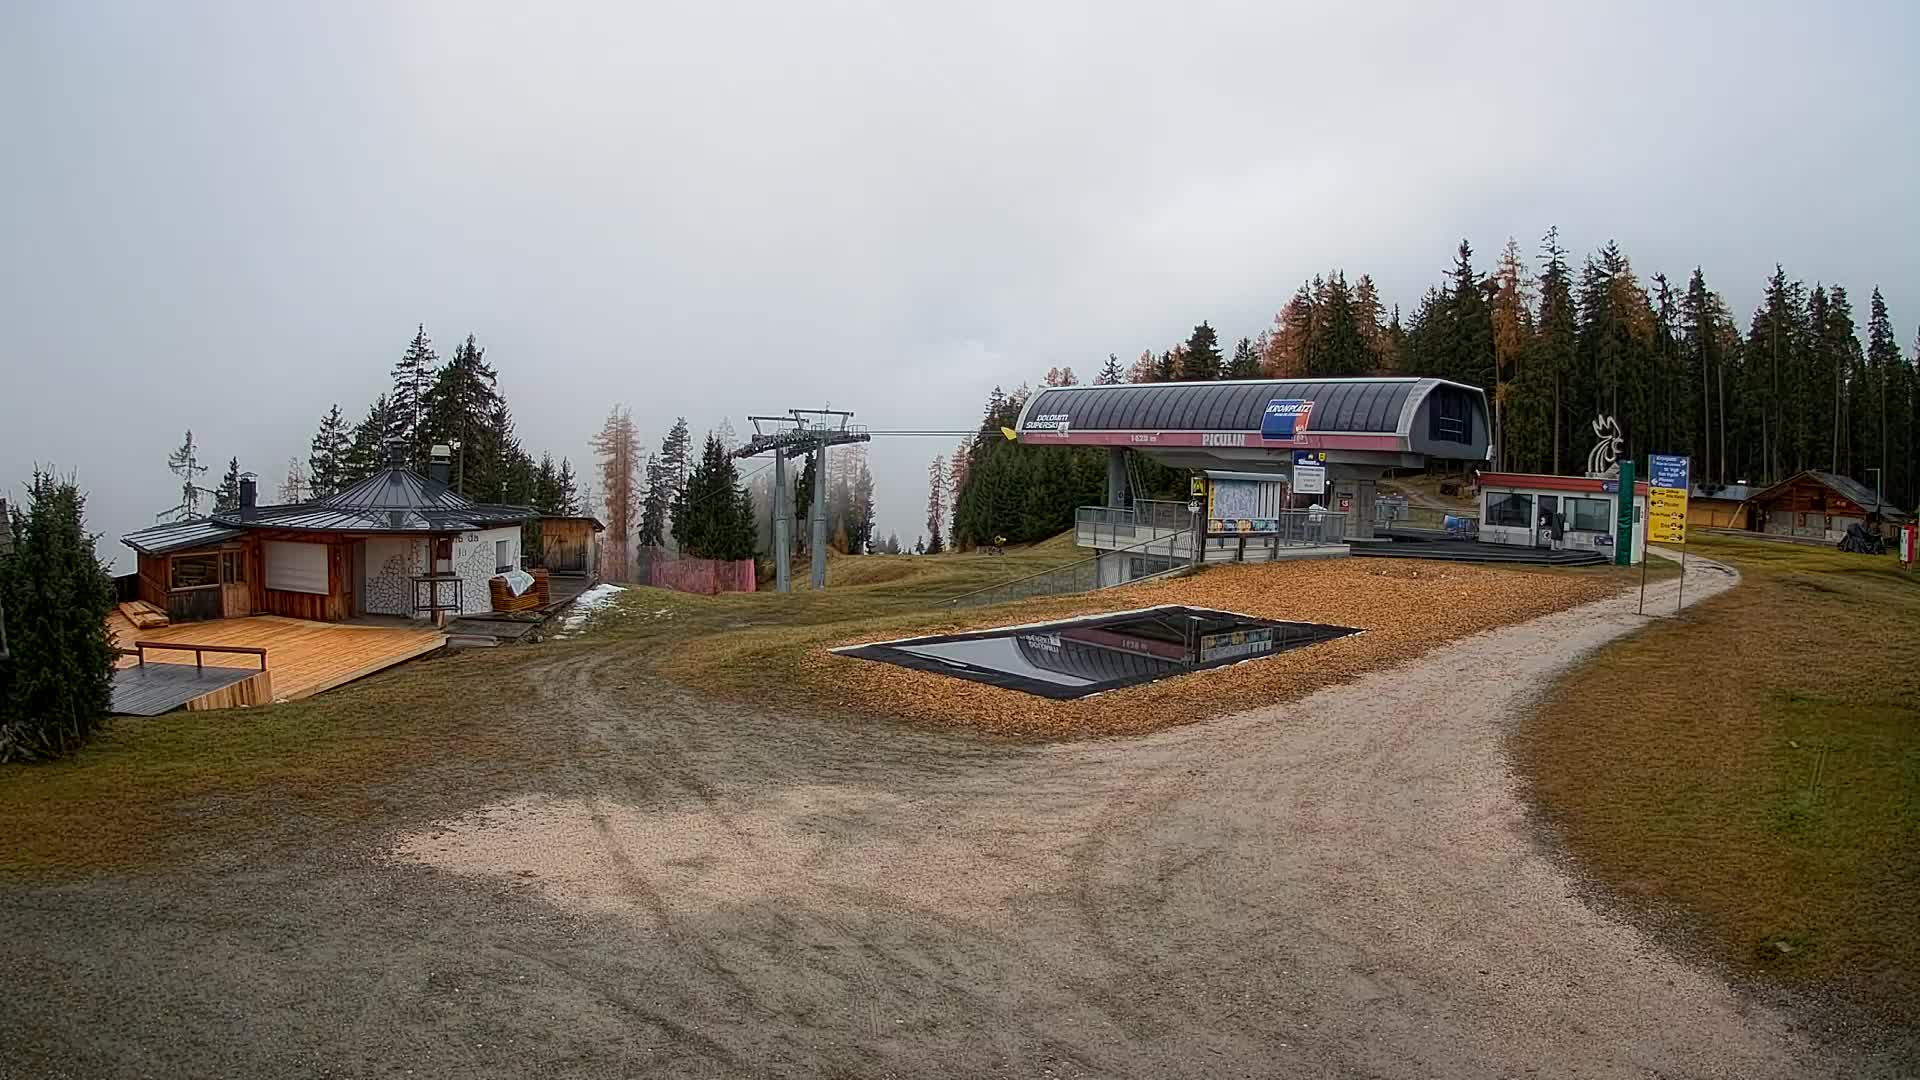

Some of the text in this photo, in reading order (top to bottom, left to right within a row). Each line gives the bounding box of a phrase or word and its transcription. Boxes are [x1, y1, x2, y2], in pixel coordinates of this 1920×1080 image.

[1266, 403, 1311, 413] KRONPLATZ
[1025, 421, 1058, 429] SUPERSKI
[1202, 433, 1246, 447] PICULIN
